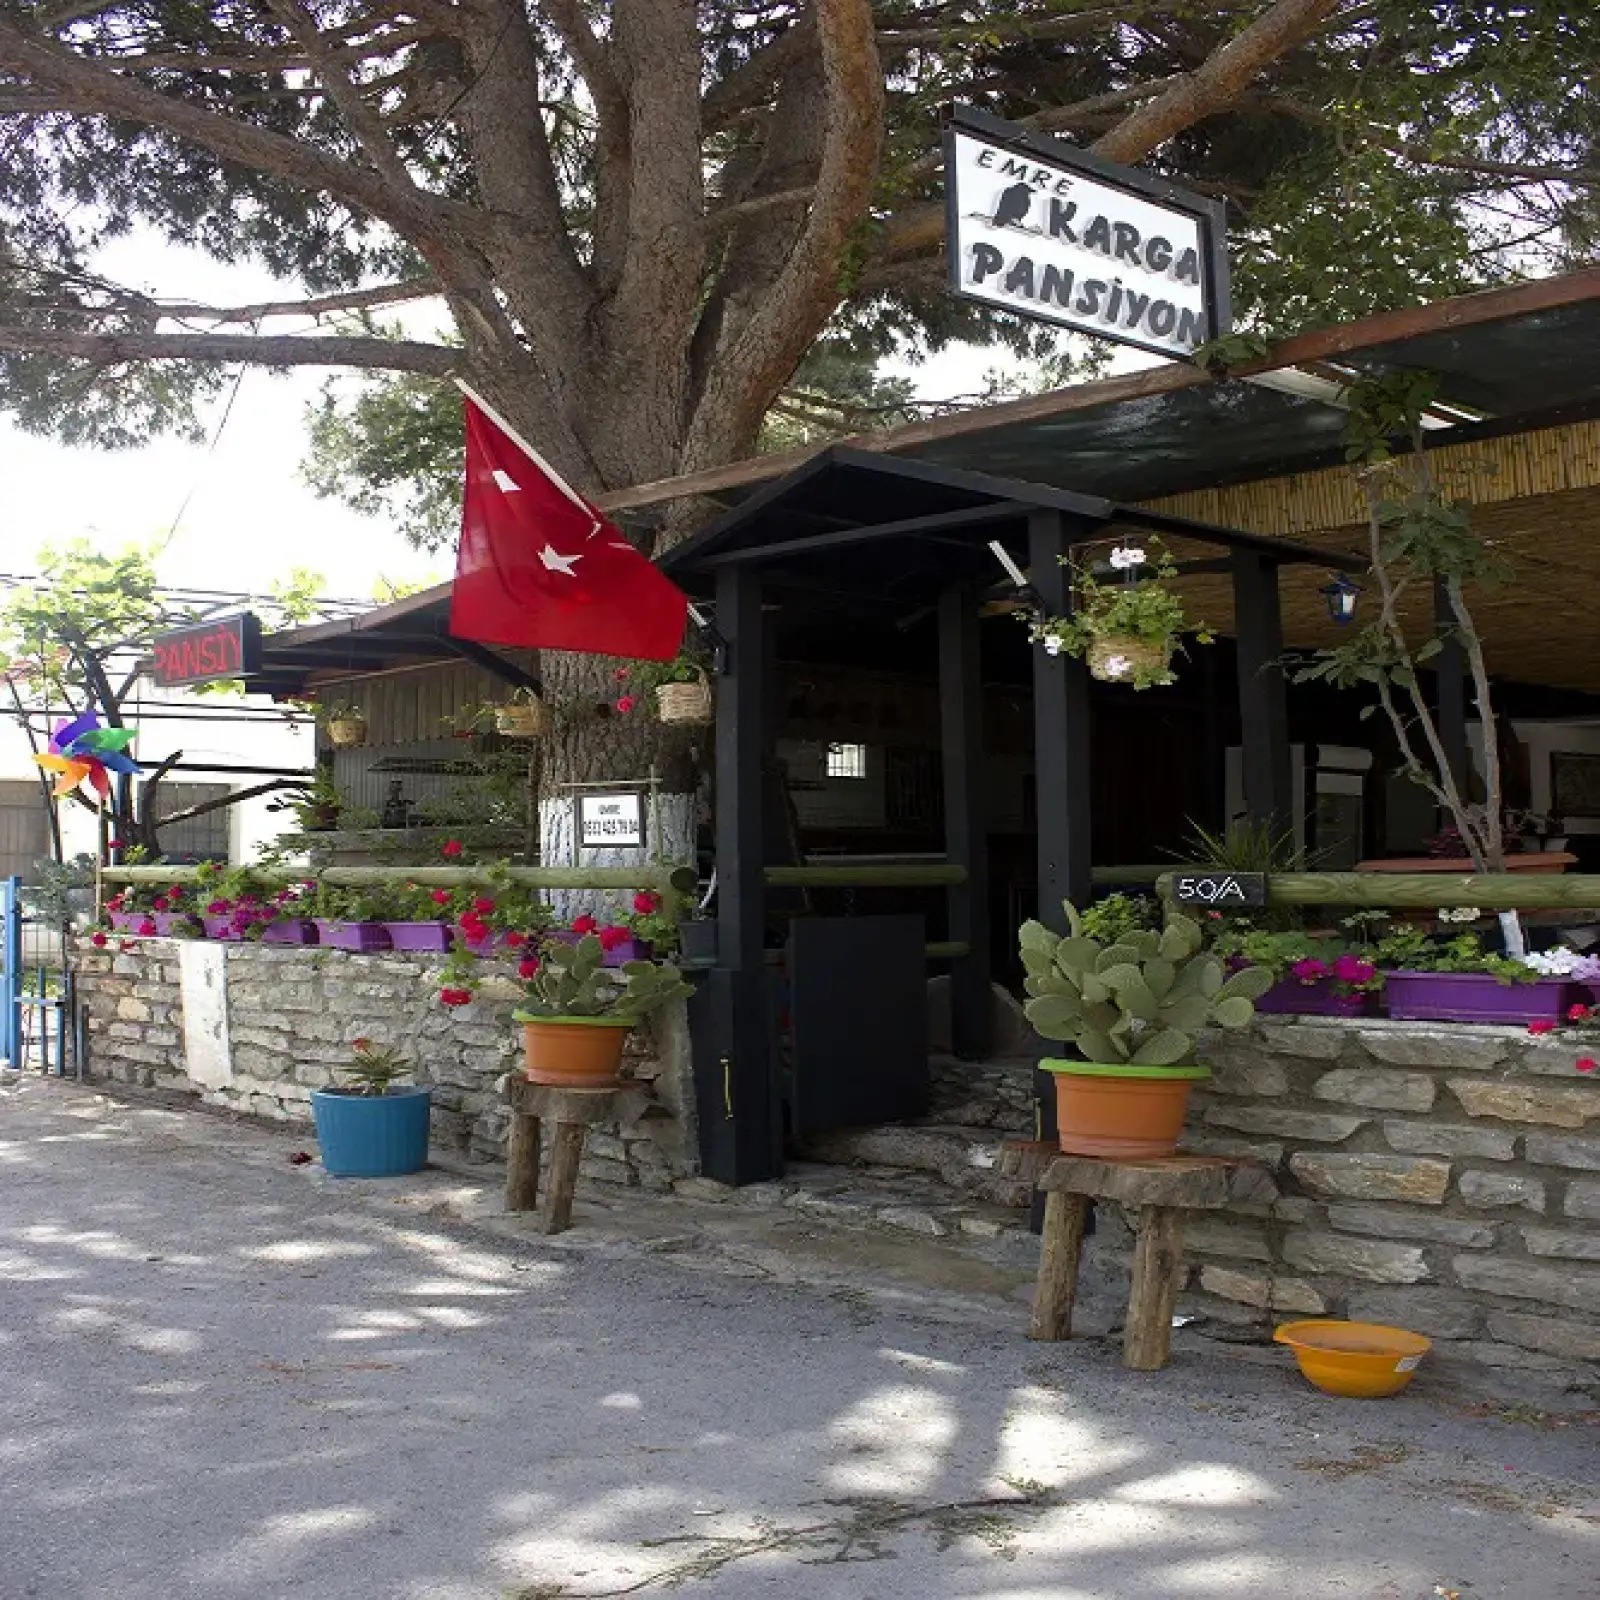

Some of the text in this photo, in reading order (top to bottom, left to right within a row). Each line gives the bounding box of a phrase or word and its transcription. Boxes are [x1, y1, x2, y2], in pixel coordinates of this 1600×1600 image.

[976, 148, 1075, 197] EMRE
[1048, 196, 1200, 286] KARGA
[969, 242, 1207, 342] PANSİYON
[1179, 876, 1245, 903] 50/A
